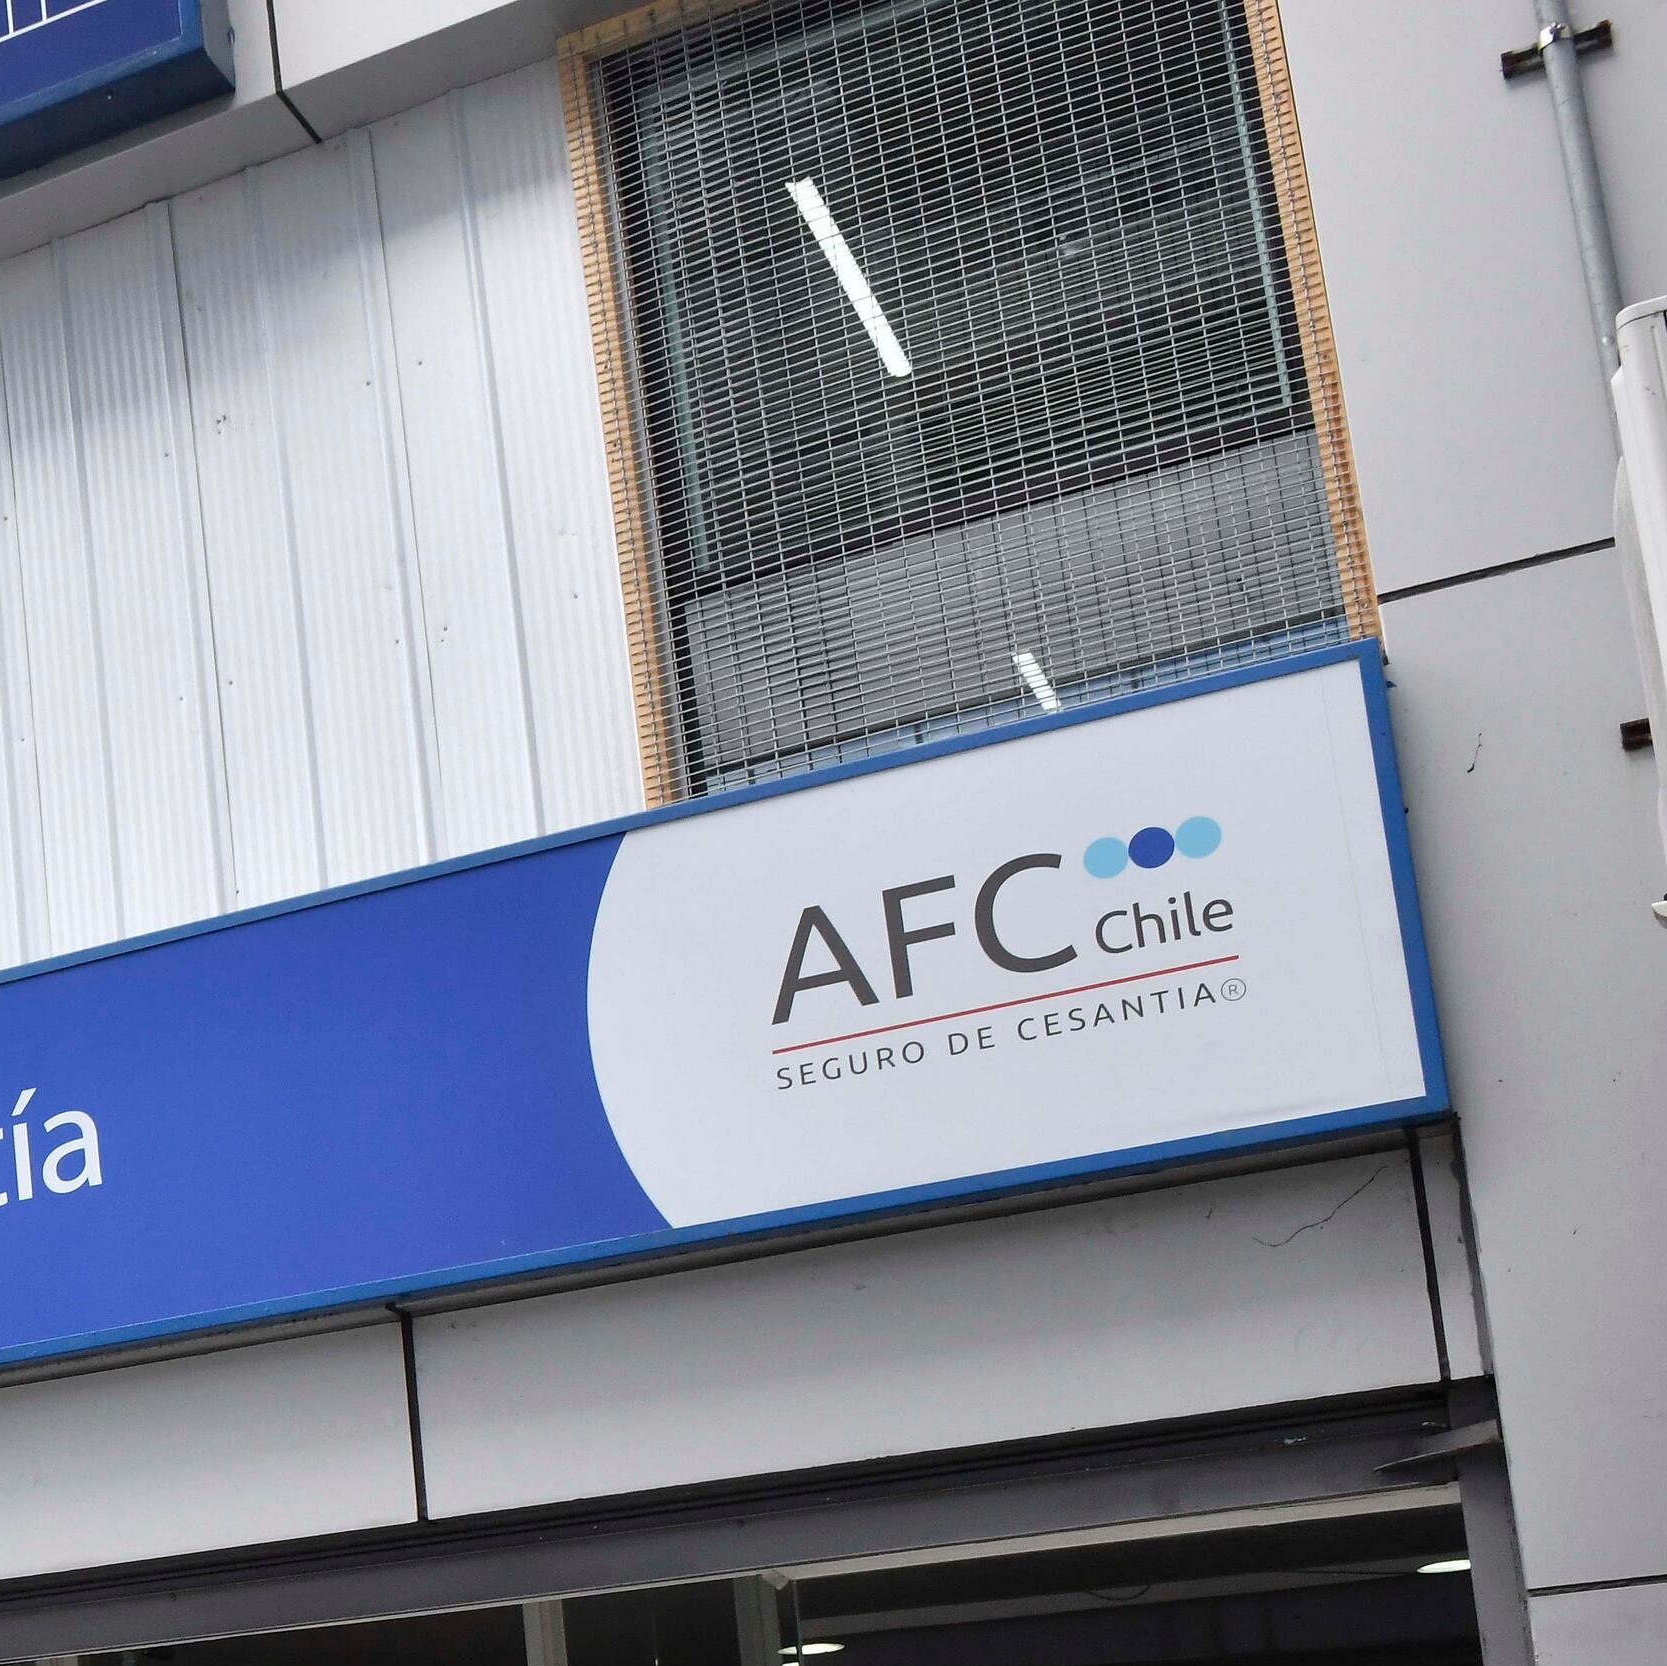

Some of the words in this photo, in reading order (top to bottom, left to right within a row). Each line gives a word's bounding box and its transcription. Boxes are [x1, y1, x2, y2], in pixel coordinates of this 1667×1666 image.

[771, 852, 1078, 1025] AFC
[1094, 891, 1234, 954] Chile
[775, 1041, 924, 1091] SEGURO
[948, 1026, 995, 1057] DE
